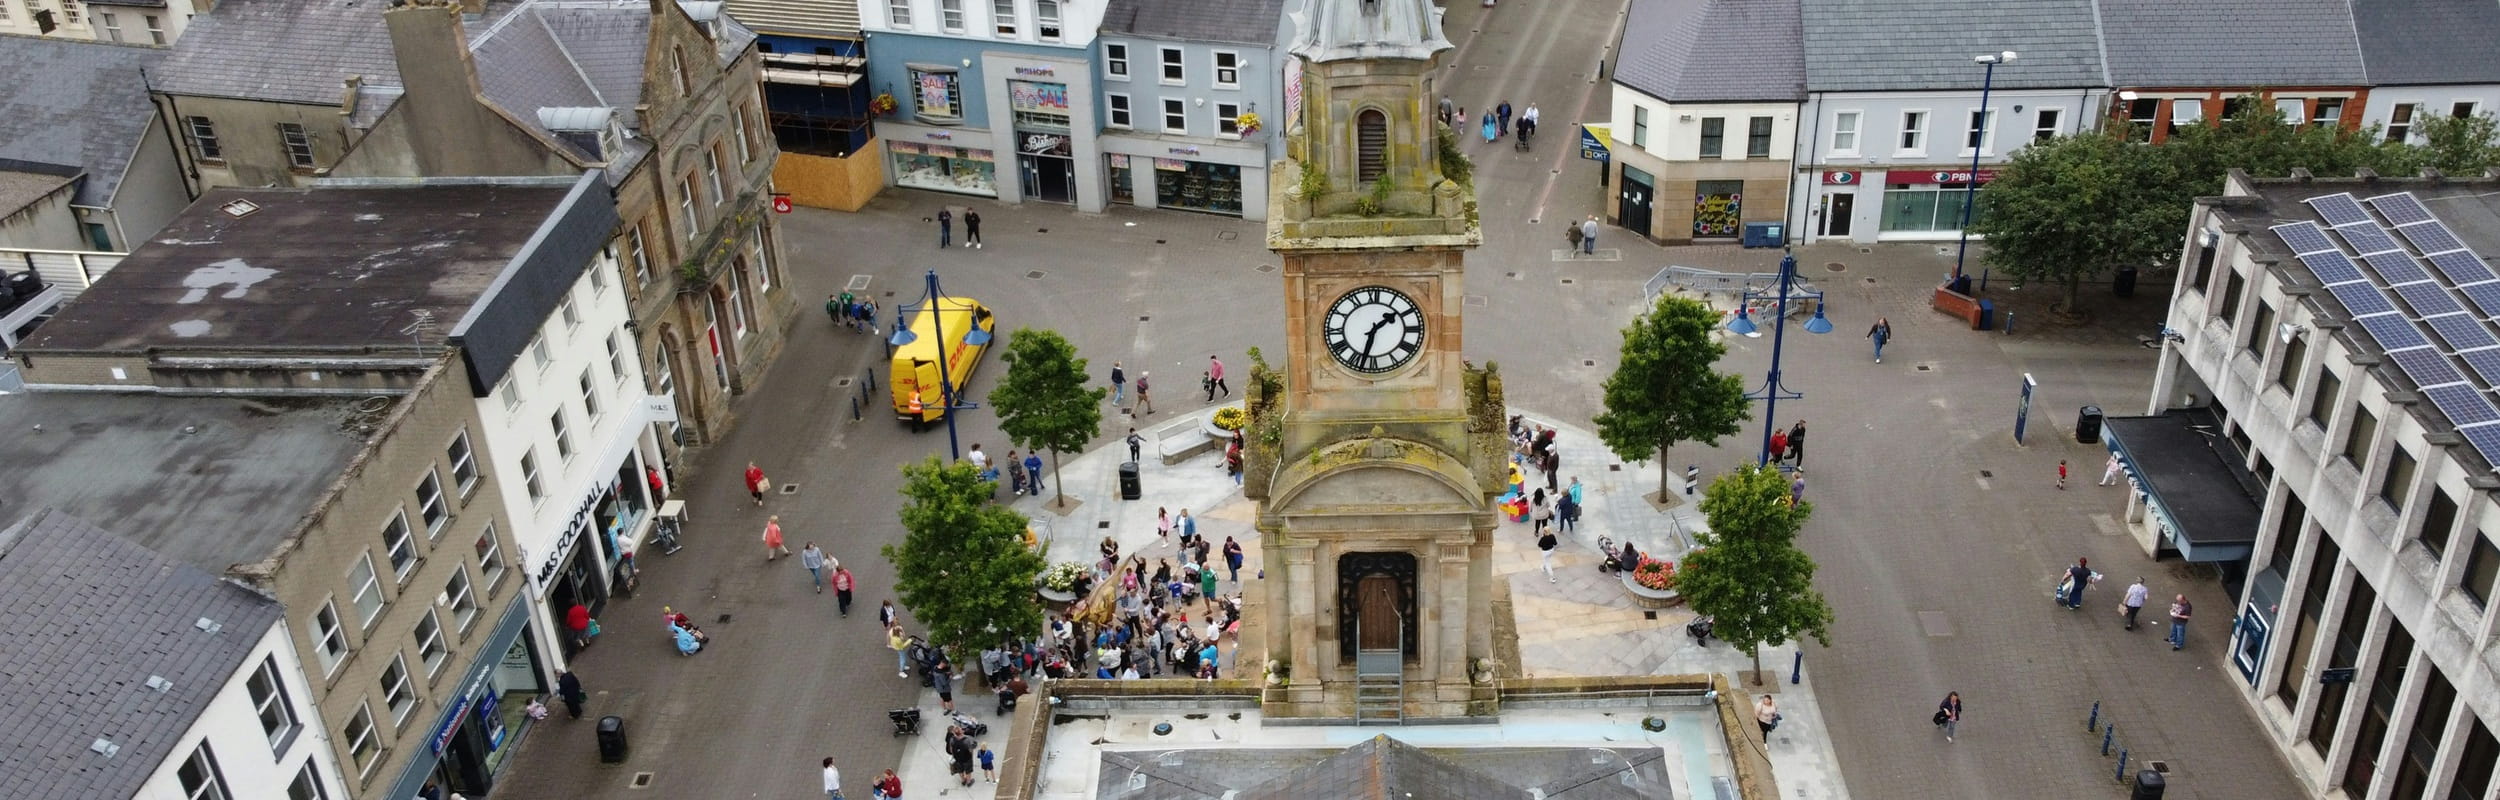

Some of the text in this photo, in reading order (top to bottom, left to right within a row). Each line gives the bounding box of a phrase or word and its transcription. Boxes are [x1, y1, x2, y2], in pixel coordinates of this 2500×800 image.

[1015, 67, 1054, 77] BISHOPS
[922, 78, 947, 89] SALE
[1037, 88, 1069, 108] SALE
[1592, 151, 1608, 160] OKT
[536, 480, 604, 589] M&S FOODHALL
